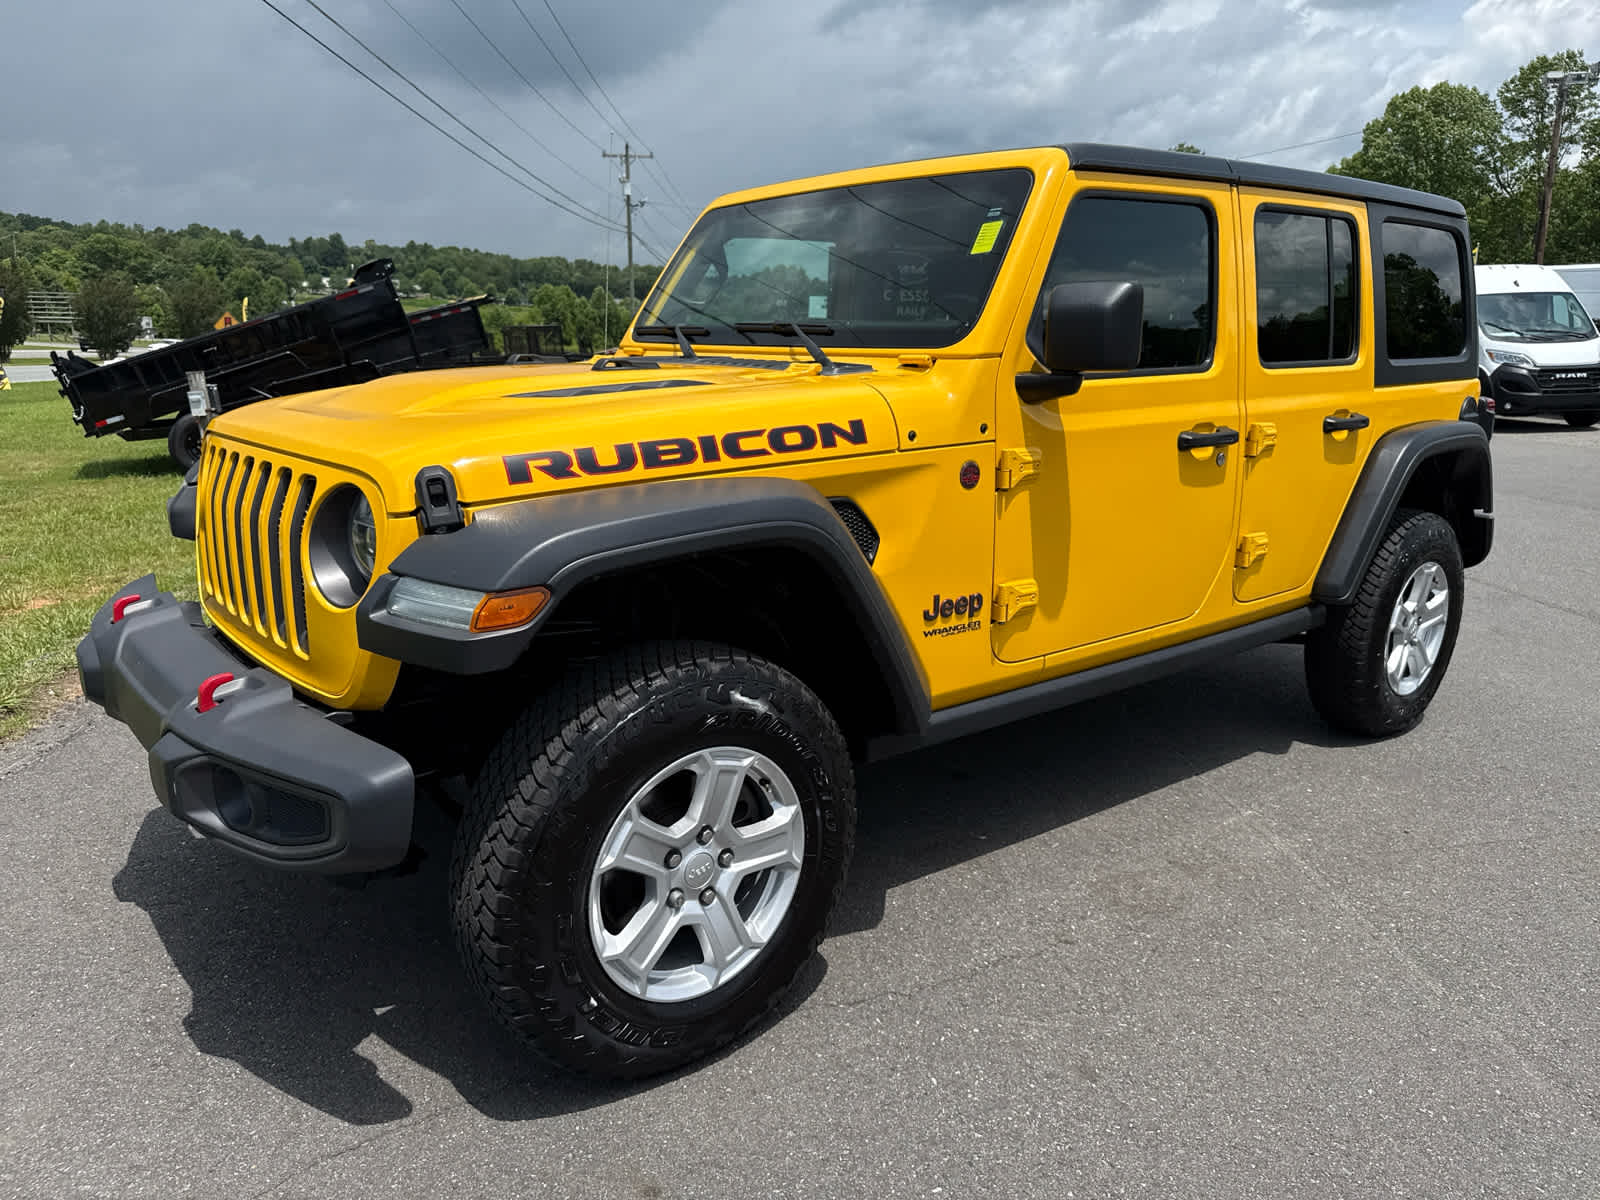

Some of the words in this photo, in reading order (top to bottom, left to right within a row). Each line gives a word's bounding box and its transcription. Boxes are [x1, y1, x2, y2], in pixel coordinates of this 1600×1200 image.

[502, 419, 868, 486] RUBICON
[923, 592, 983, 621] Jeep
[923, 620, 981, 638] WRANGLER
